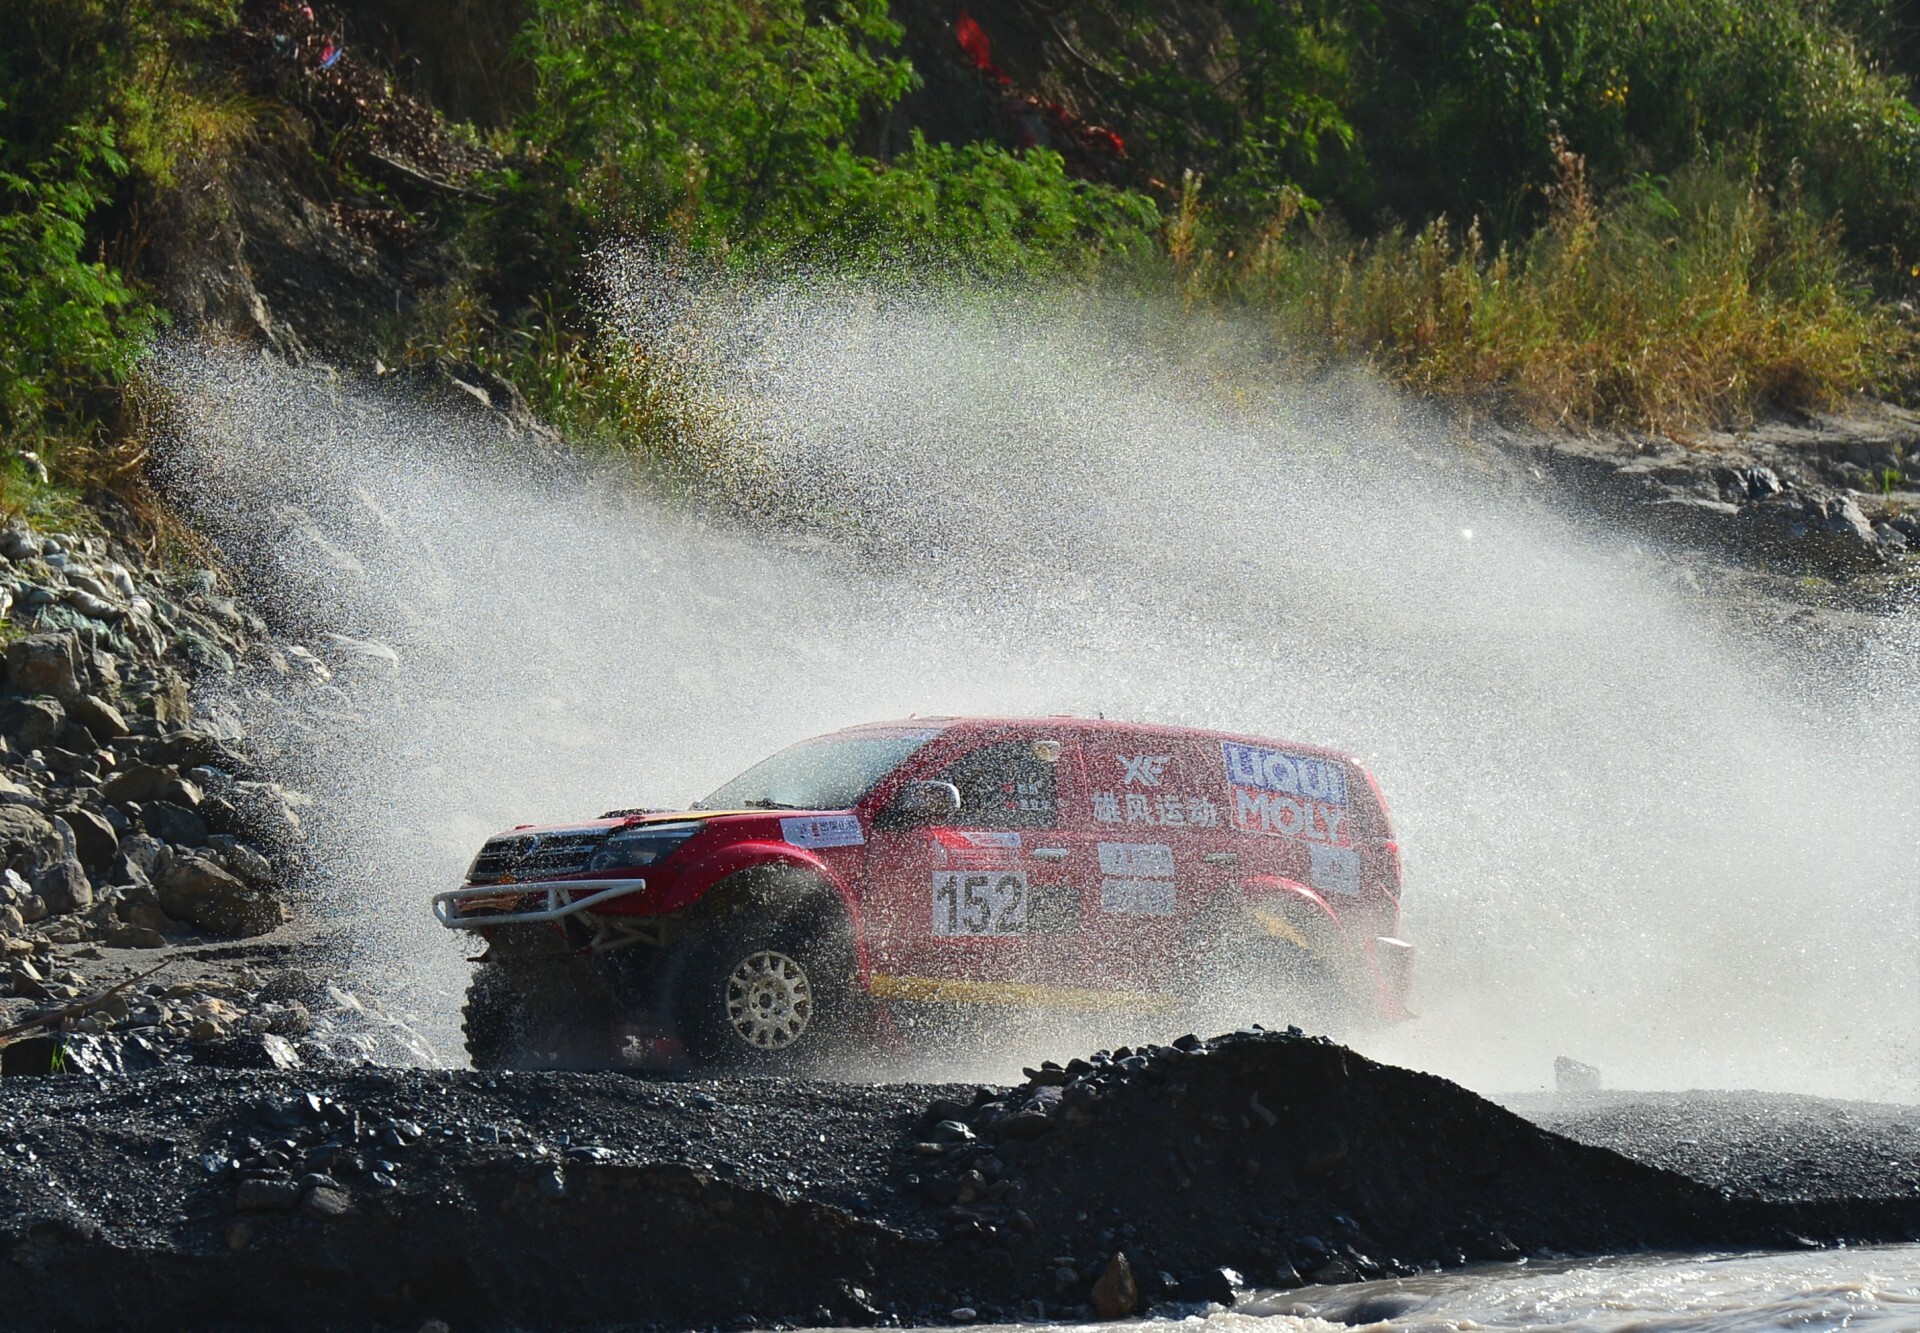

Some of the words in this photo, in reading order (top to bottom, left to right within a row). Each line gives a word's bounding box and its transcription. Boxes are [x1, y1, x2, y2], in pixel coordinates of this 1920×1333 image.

[1230, 748, 1343, 804] LIQUI
[1235, 789, 1346, 842] MOLY
[936, 874, 1024, 933] 152
